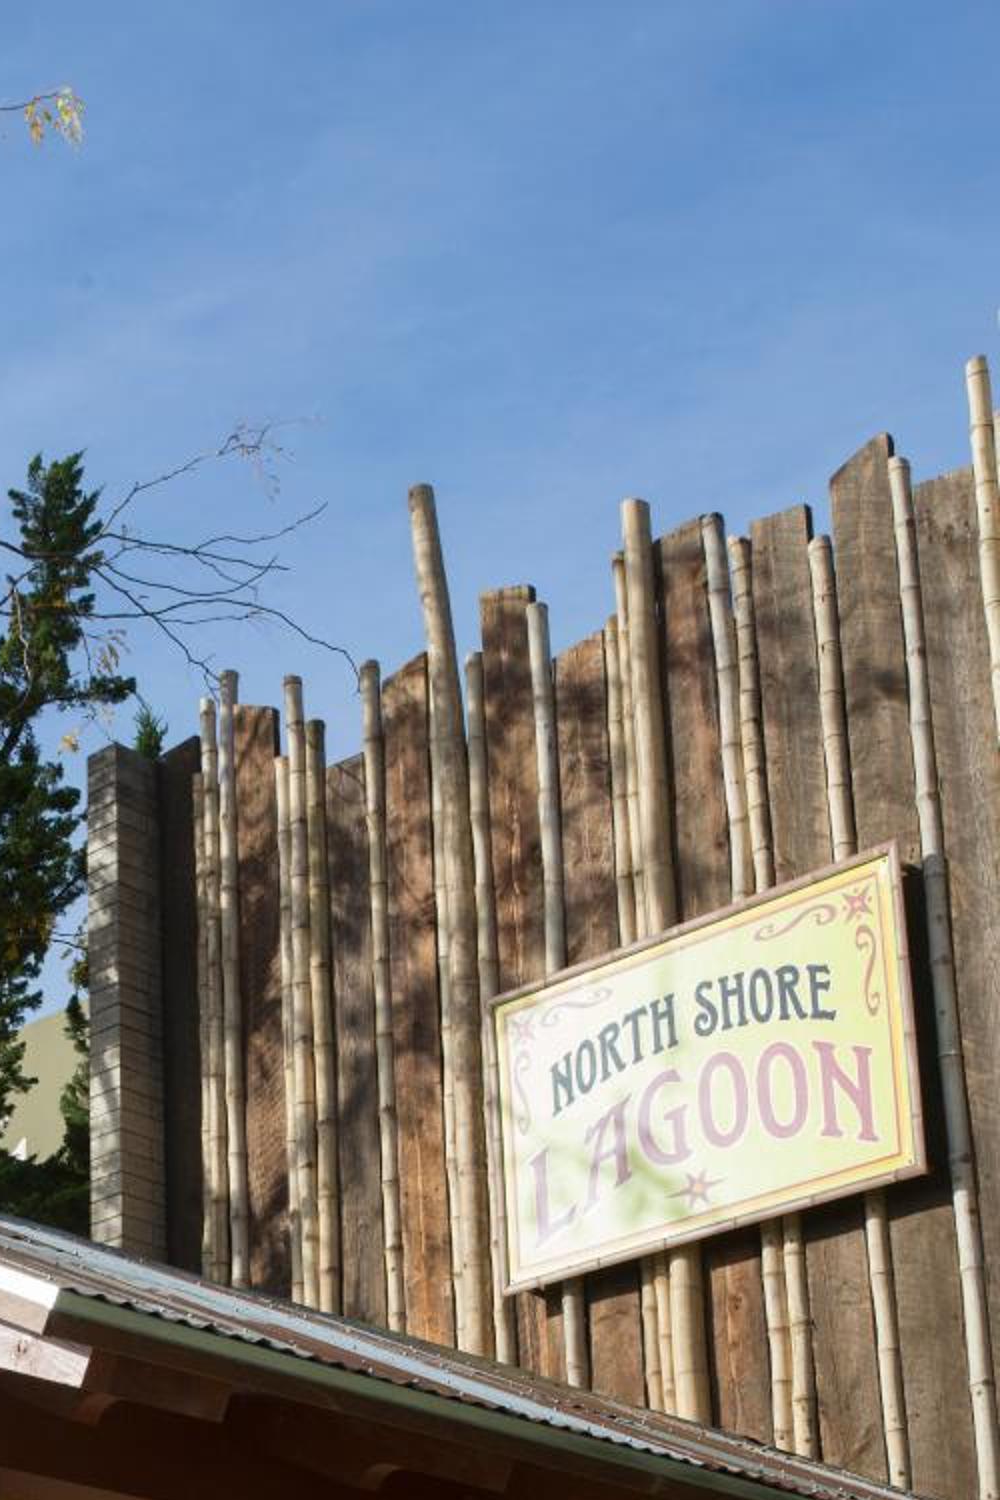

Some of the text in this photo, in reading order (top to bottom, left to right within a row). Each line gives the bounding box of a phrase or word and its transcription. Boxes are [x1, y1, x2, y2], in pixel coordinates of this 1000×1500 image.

[550, 963, 837, 1117] NORTH SHORE
[528, 1039, 880, 1249] LAGOON
